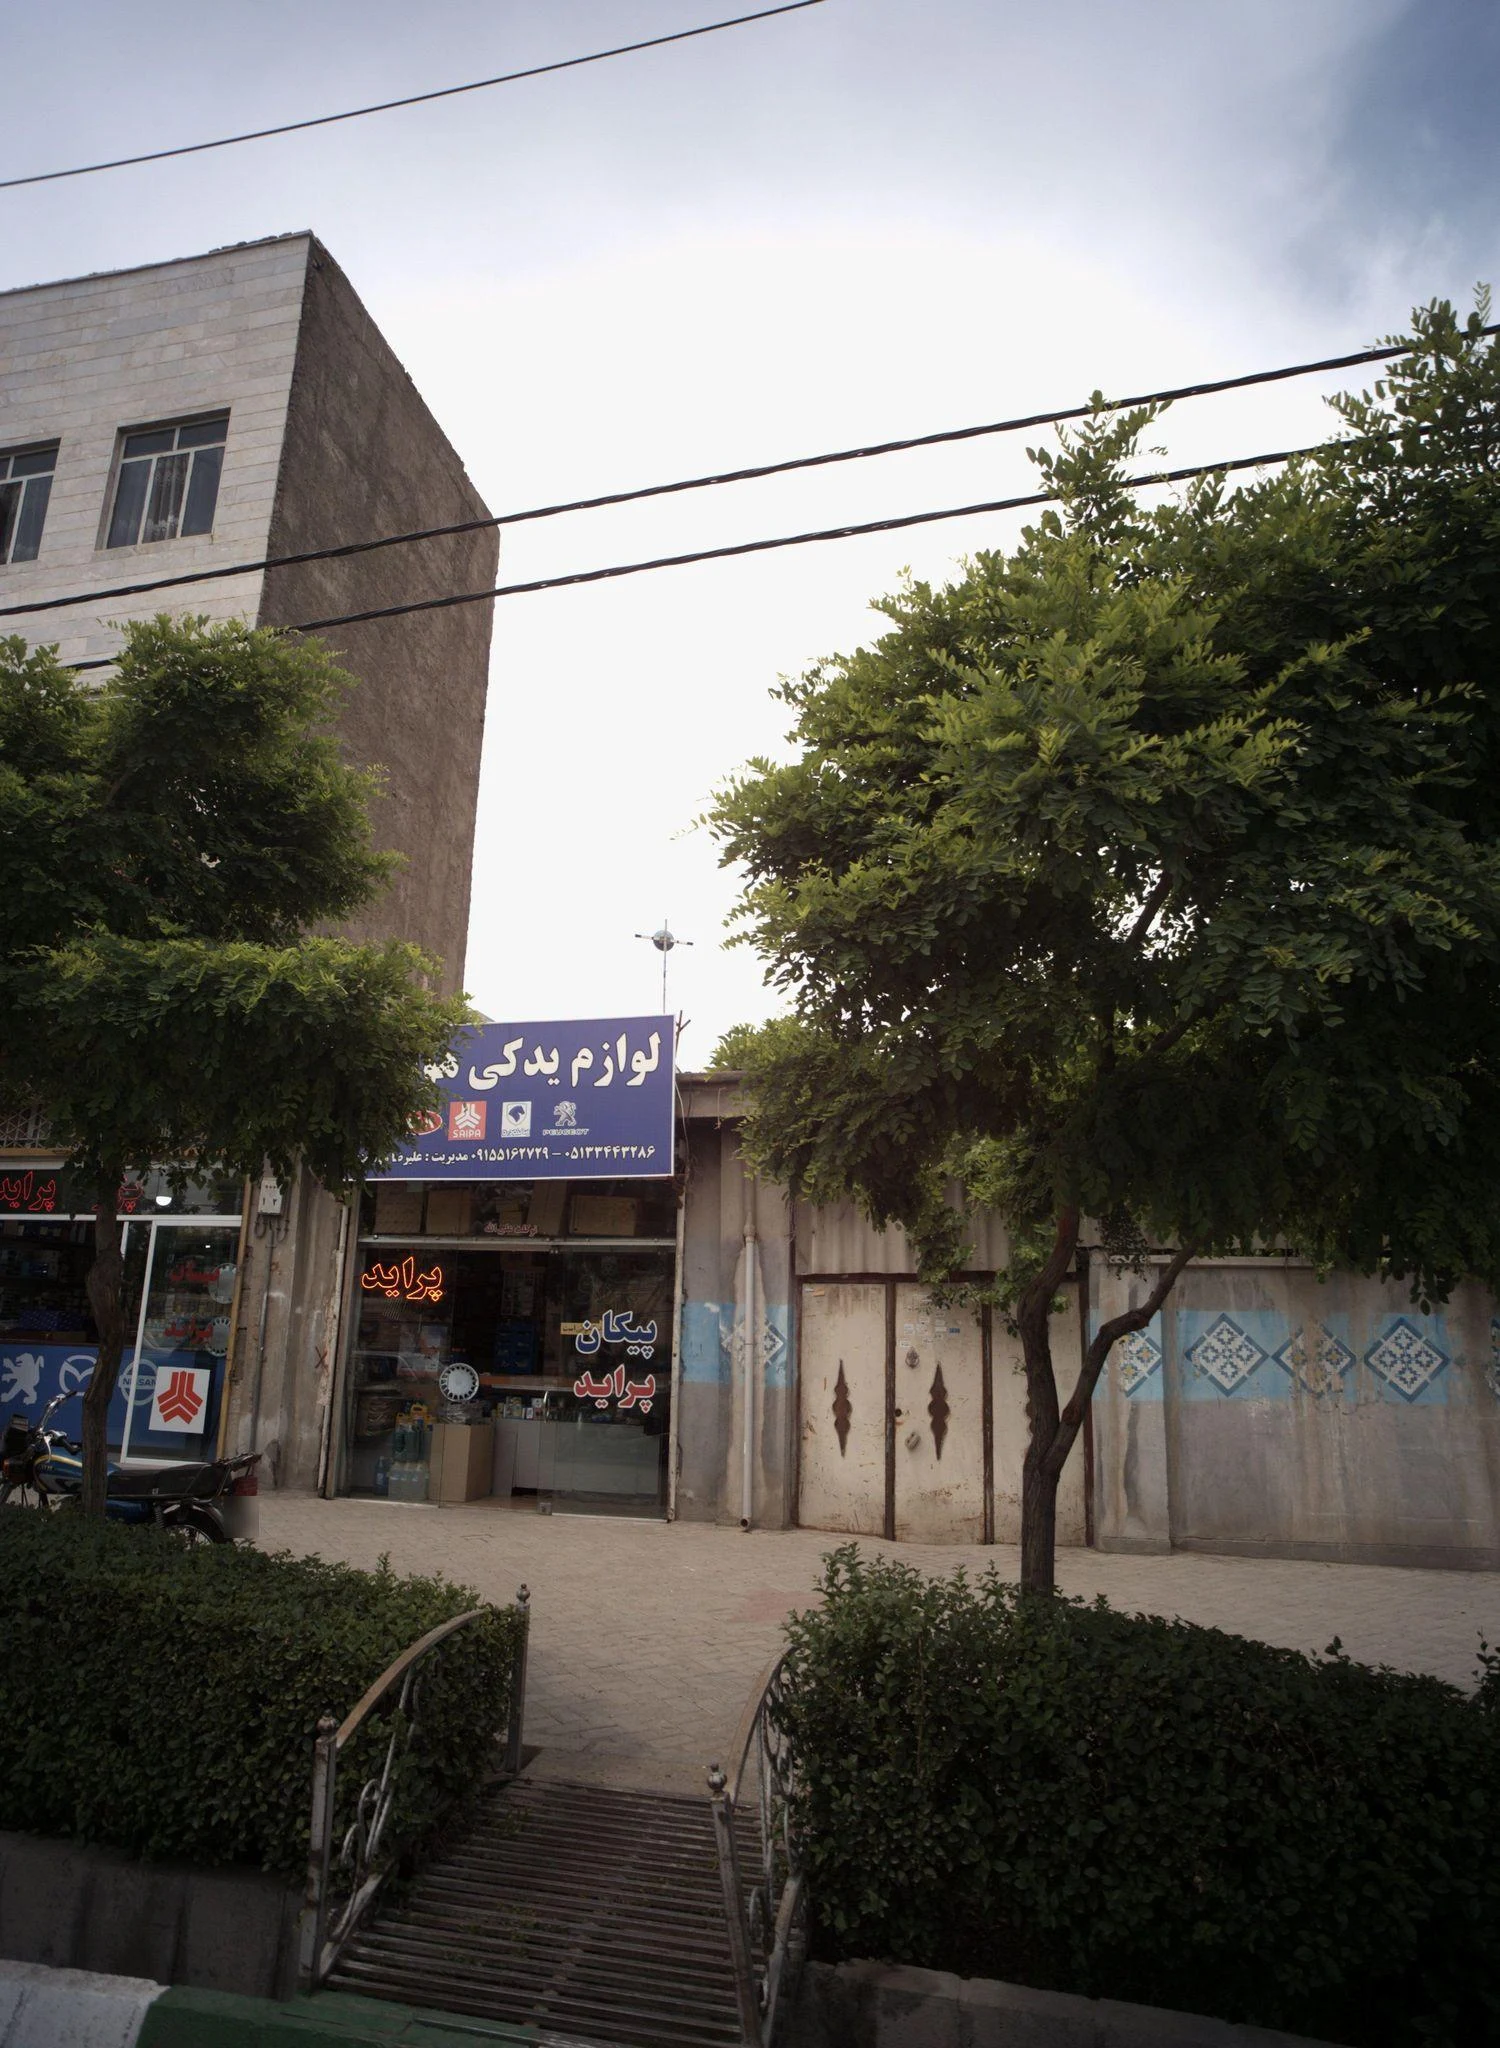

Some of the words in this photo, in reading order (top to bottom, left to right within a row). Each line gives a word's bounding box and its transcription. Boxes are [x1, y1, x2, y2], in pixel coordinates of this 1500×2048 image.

[468, 1037, 560, 1091] یدکی
[571, 1031, 661, 1088] لوازم
[453, 1129, 481, 1138] SAIPA
[543, 1128, 589, 1136] PEUGEOT
[431, 1152, 468, 1165] مدیریت
[471, 1146, 549, 1162] ۰۹۱۵۵۱۶۲۷۲۹
[565, 1145, 655, 1159] ۰۵۱۳۳۴۴۳۲۸۶
[361, 1256, 443, 1302] پراید
[575, 1309, 657, 1360] پیکان
[573, 1363, 656, 1414] پراید
